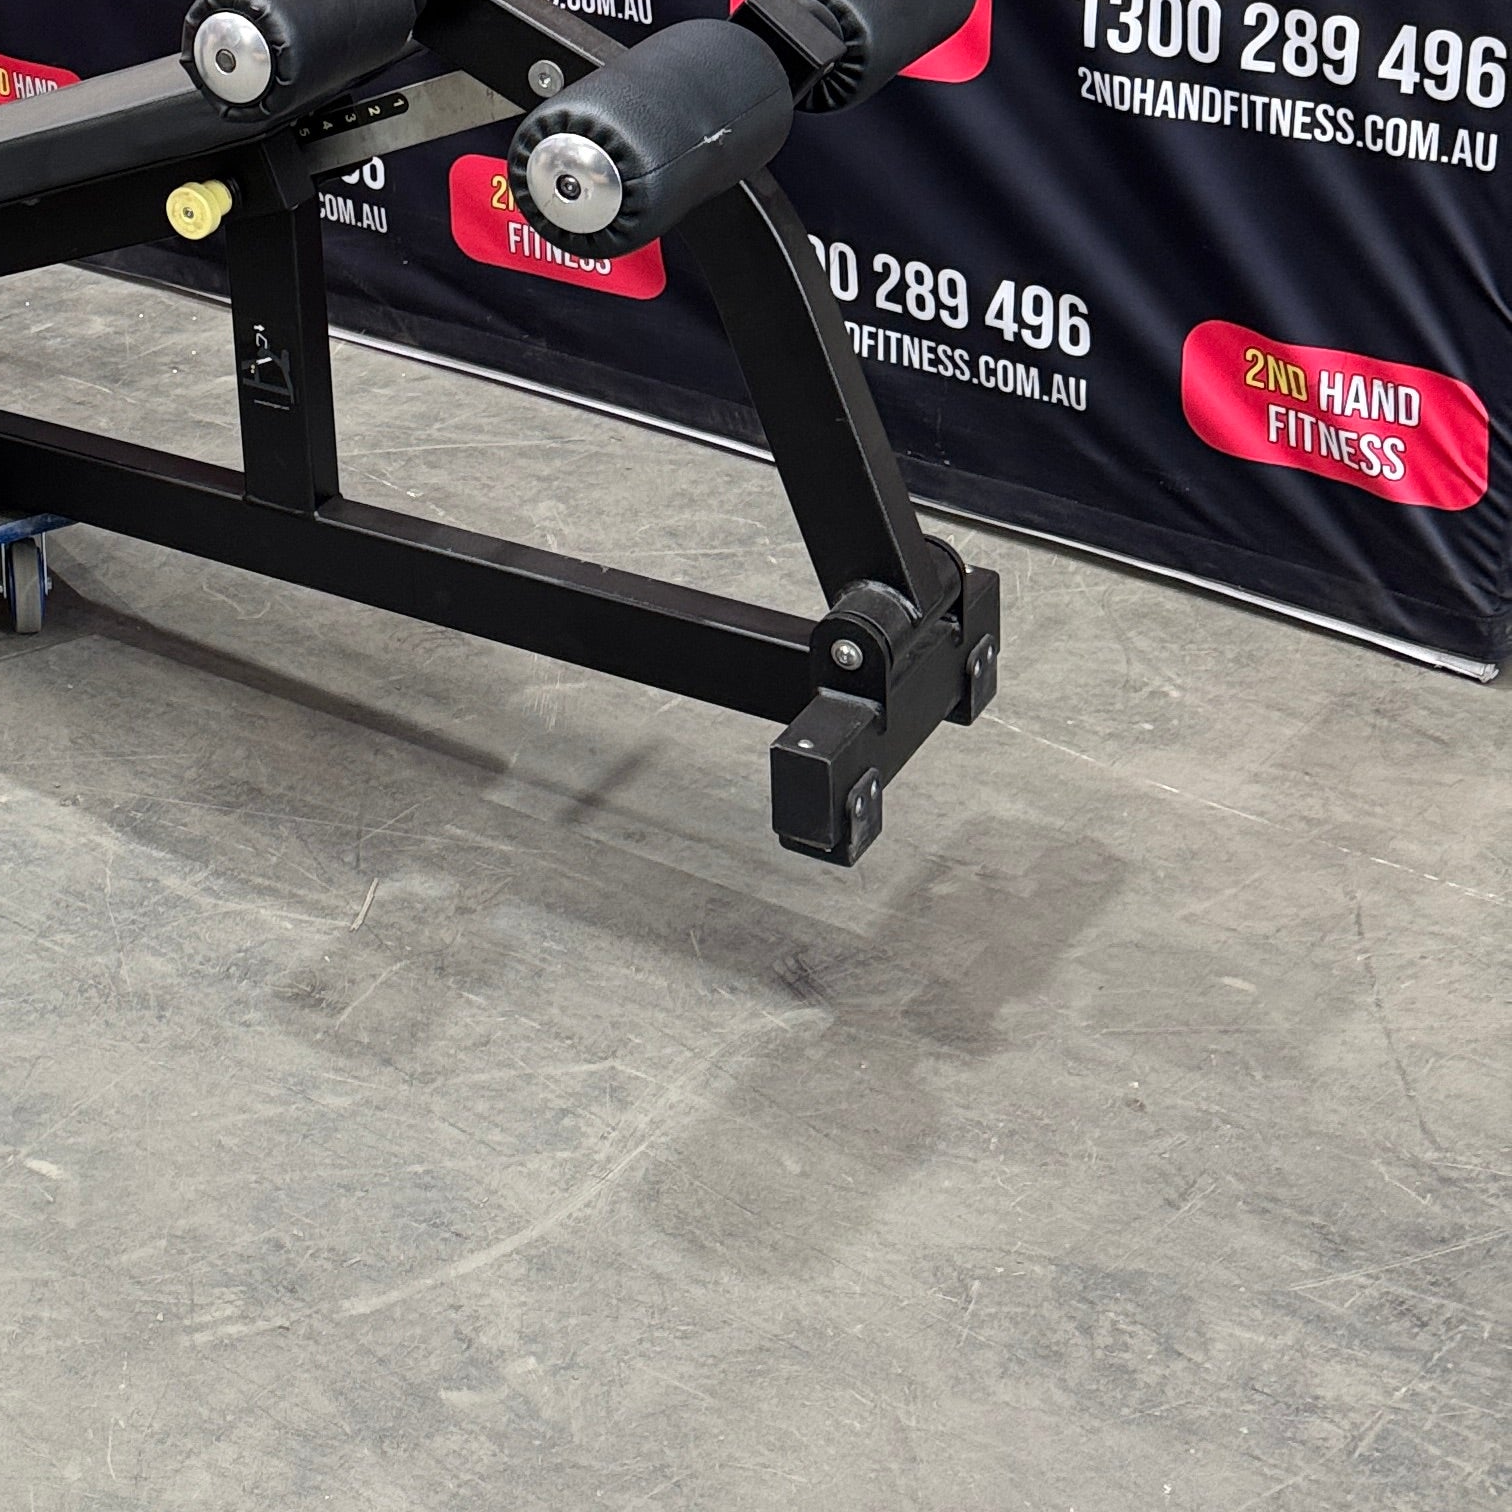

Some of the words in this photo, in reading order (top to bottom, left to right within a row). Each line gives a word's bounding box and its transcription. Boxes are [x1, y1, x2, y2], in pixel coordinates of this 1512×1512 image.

[1240, 0, 1361, 86] 289
[1378, 22, 1510, 110] 496
[367, 105, 381, 117] 2
[1078, 67, 1498, 174] 2NDHANDFITNESS.COM.AU
[873, 251, 970, 330] 289
[985, 278, 1092, 358] 496
[1244, 348, 1308, 402] 2ND
[1319, 370, 1421, 428] HAND
[1267, 404, 1407, 483] FITNESS
